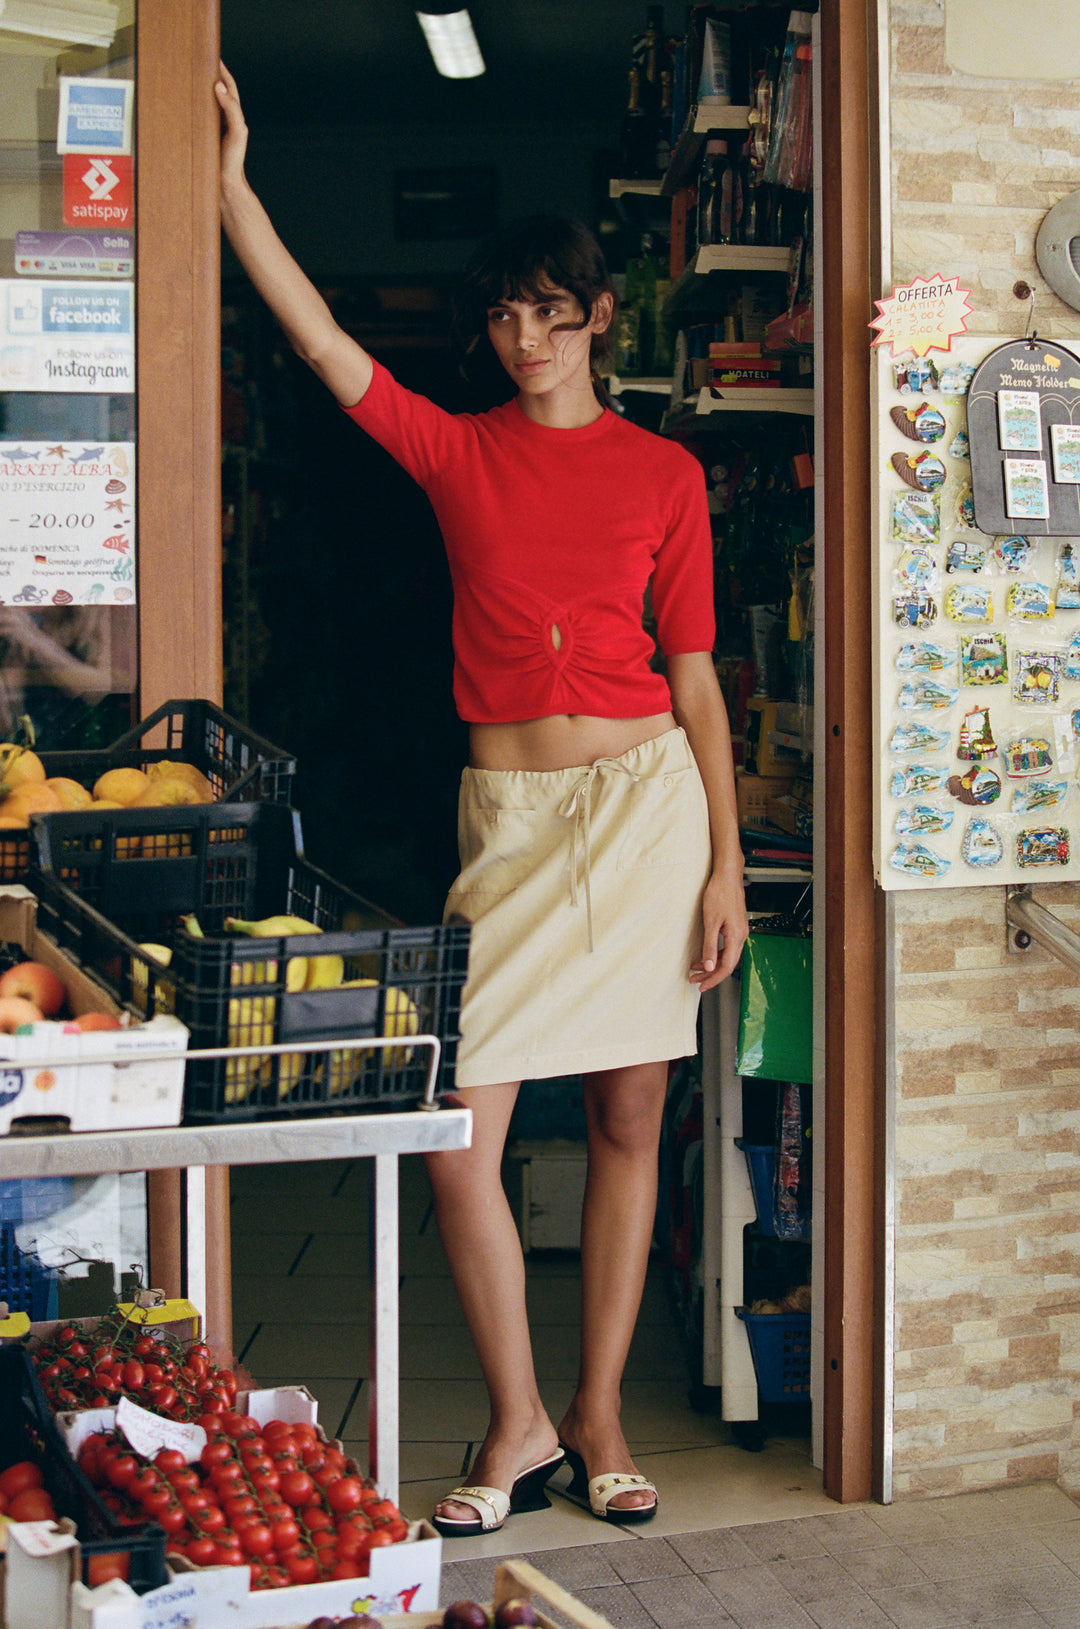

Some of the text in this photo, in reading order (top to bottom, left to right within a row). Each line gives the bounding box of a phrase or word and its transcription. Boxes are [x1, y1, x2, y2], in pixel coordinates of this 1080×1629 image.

[72, 204, 128, 221] satispay
[103, 237, 129, 248] Sella
[53, 296, 120, 306] FOLLOW US ON
[898, 284, 953, 303] OFFERTA
[889, 299, 945, 314] CALAMITA
[49, 306, 121, 324] facebook
[57, 349, 90, 359] Follow
[45, 360, 129, 385] Instagram
[1000, 374, 1069, 388] Memo Holder
[64, 464, 112, 476] ALBA
[29, 513, 95, 528] 20.00
